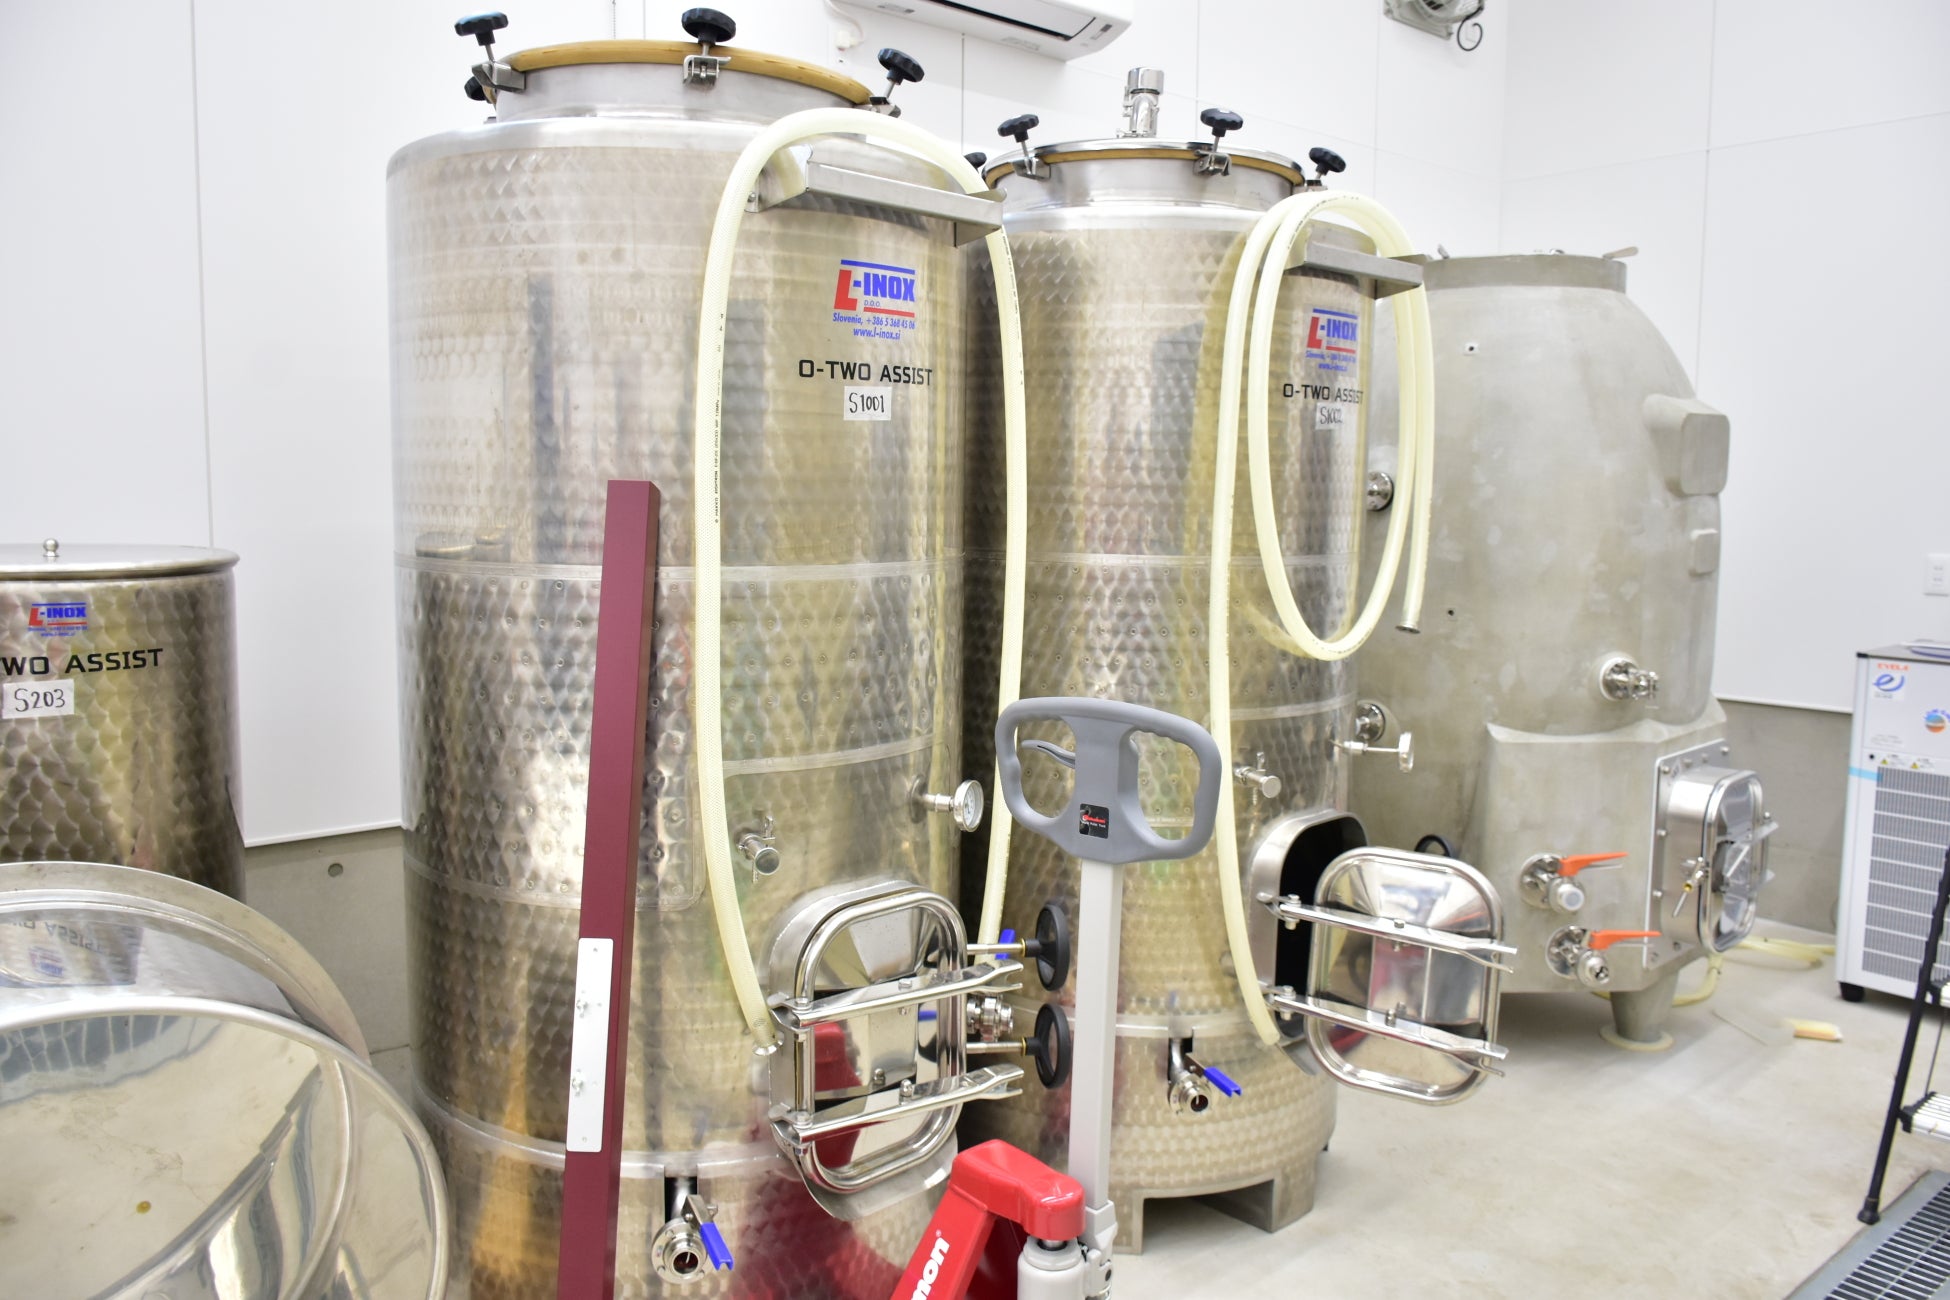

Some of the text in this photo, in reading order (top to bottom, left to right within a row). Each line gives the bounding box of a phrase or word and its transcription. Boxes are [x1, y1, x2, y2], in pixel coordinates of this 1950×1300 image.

[833, 269, 915, 311] L-INOX
[833, 312, 863, 325] Slovenia,
[866, 316, 883, 326] +386
[884, 318, 889, 326] 5
[901, 319, 908, 328] 45
[853, 326, 901, 340] www.l-inox.si
[1306, 316, 1357, 349] L-INOX
[799, 359, 933, 386] O-TWO ASSIST
[848, 392, 885, 414] S1001
[1283, 383, 1364, 404] O-TWO ASSIST
[28, 606, 87, 626] L-INOX
[65, 648, 163, 674] ASSIST
[14, 687, 66, 713] S203
